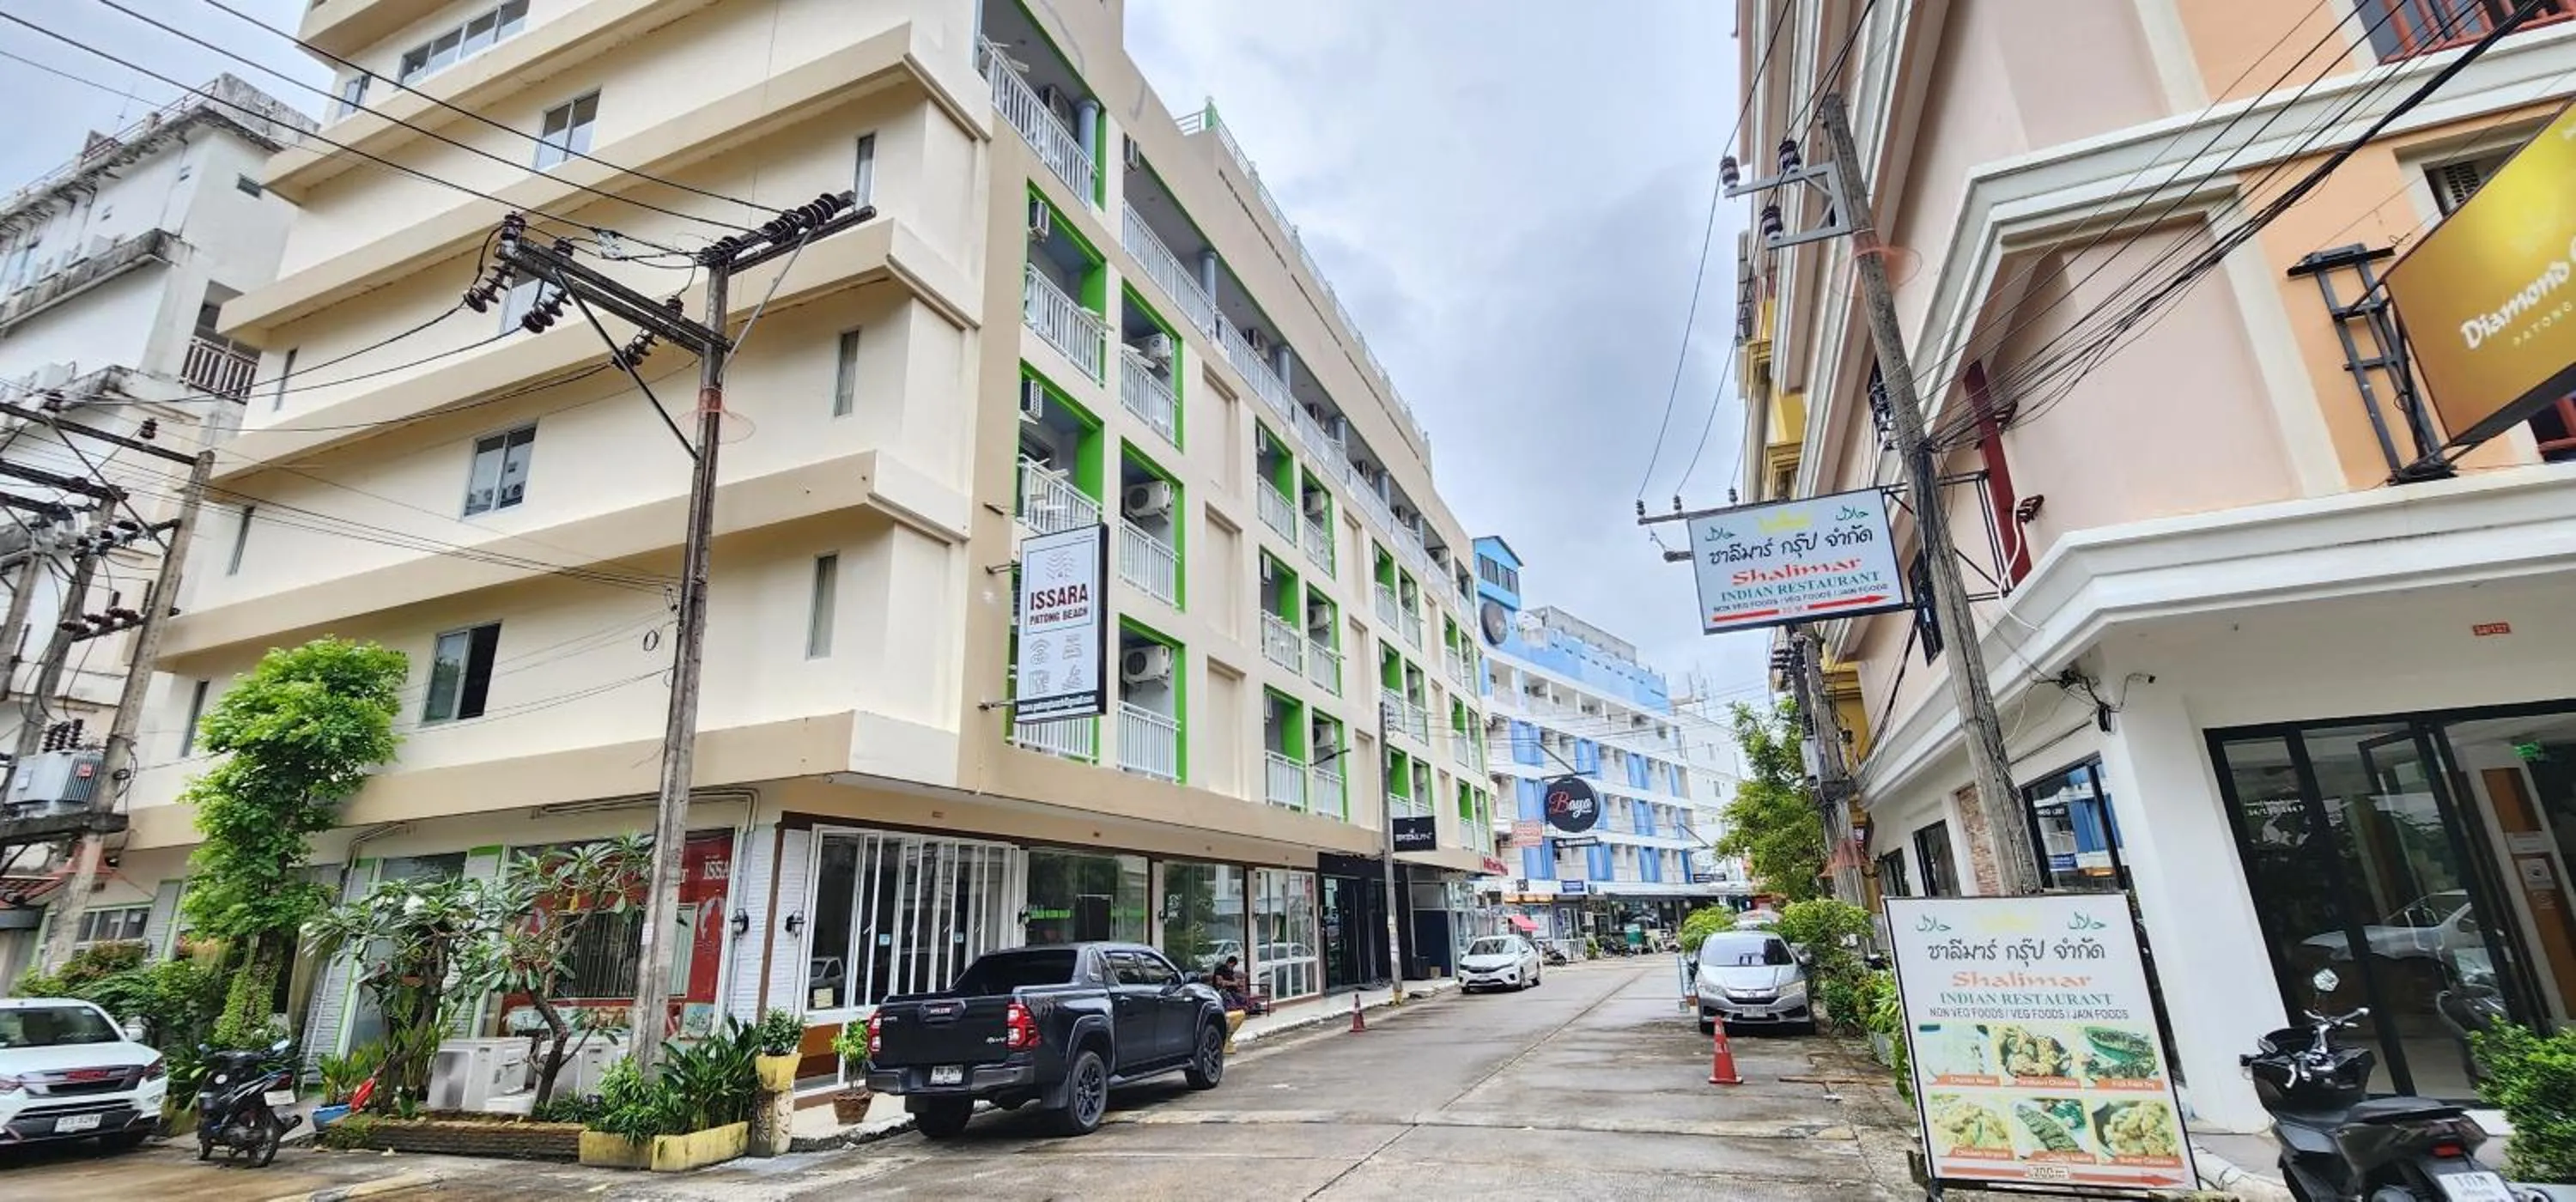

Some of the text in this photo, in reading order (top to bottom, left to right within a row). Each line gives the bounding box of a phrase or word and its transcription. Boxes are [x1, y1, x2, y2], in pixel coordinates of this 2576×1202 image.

[1709, 537, 1774, 565] ชาลีมาร์
[1825, 524, 1873, 547] จำกัด
[1731, 558, 1861, 586] Shalimar
[1030, 583, 1089, 610] ISSARA
[1721, 571, 1880, 601] INDIAN RESTAURANT
[1030, 606, 1088, 626] PATONG BEACH
[1927, 937, 2105, 968] ชาลีมาร์ กรุ๊ป จำกัด
[1952, 970, 2093, 987] Shalimar
[1940, 992, 2114, 1005] INDIAN RESTAURANT
[1929, 1007, 1950, 1017] NON
[1953, 1008, 1971, 1017] VEG
[1971, 1008, 2005, 1018] FOODS
[2011, 1009, 2031, 1019] VEG
[2032, 1010, 2065, 1019] FOODS
[2094, 1010, 2129, 1020] FOODS
